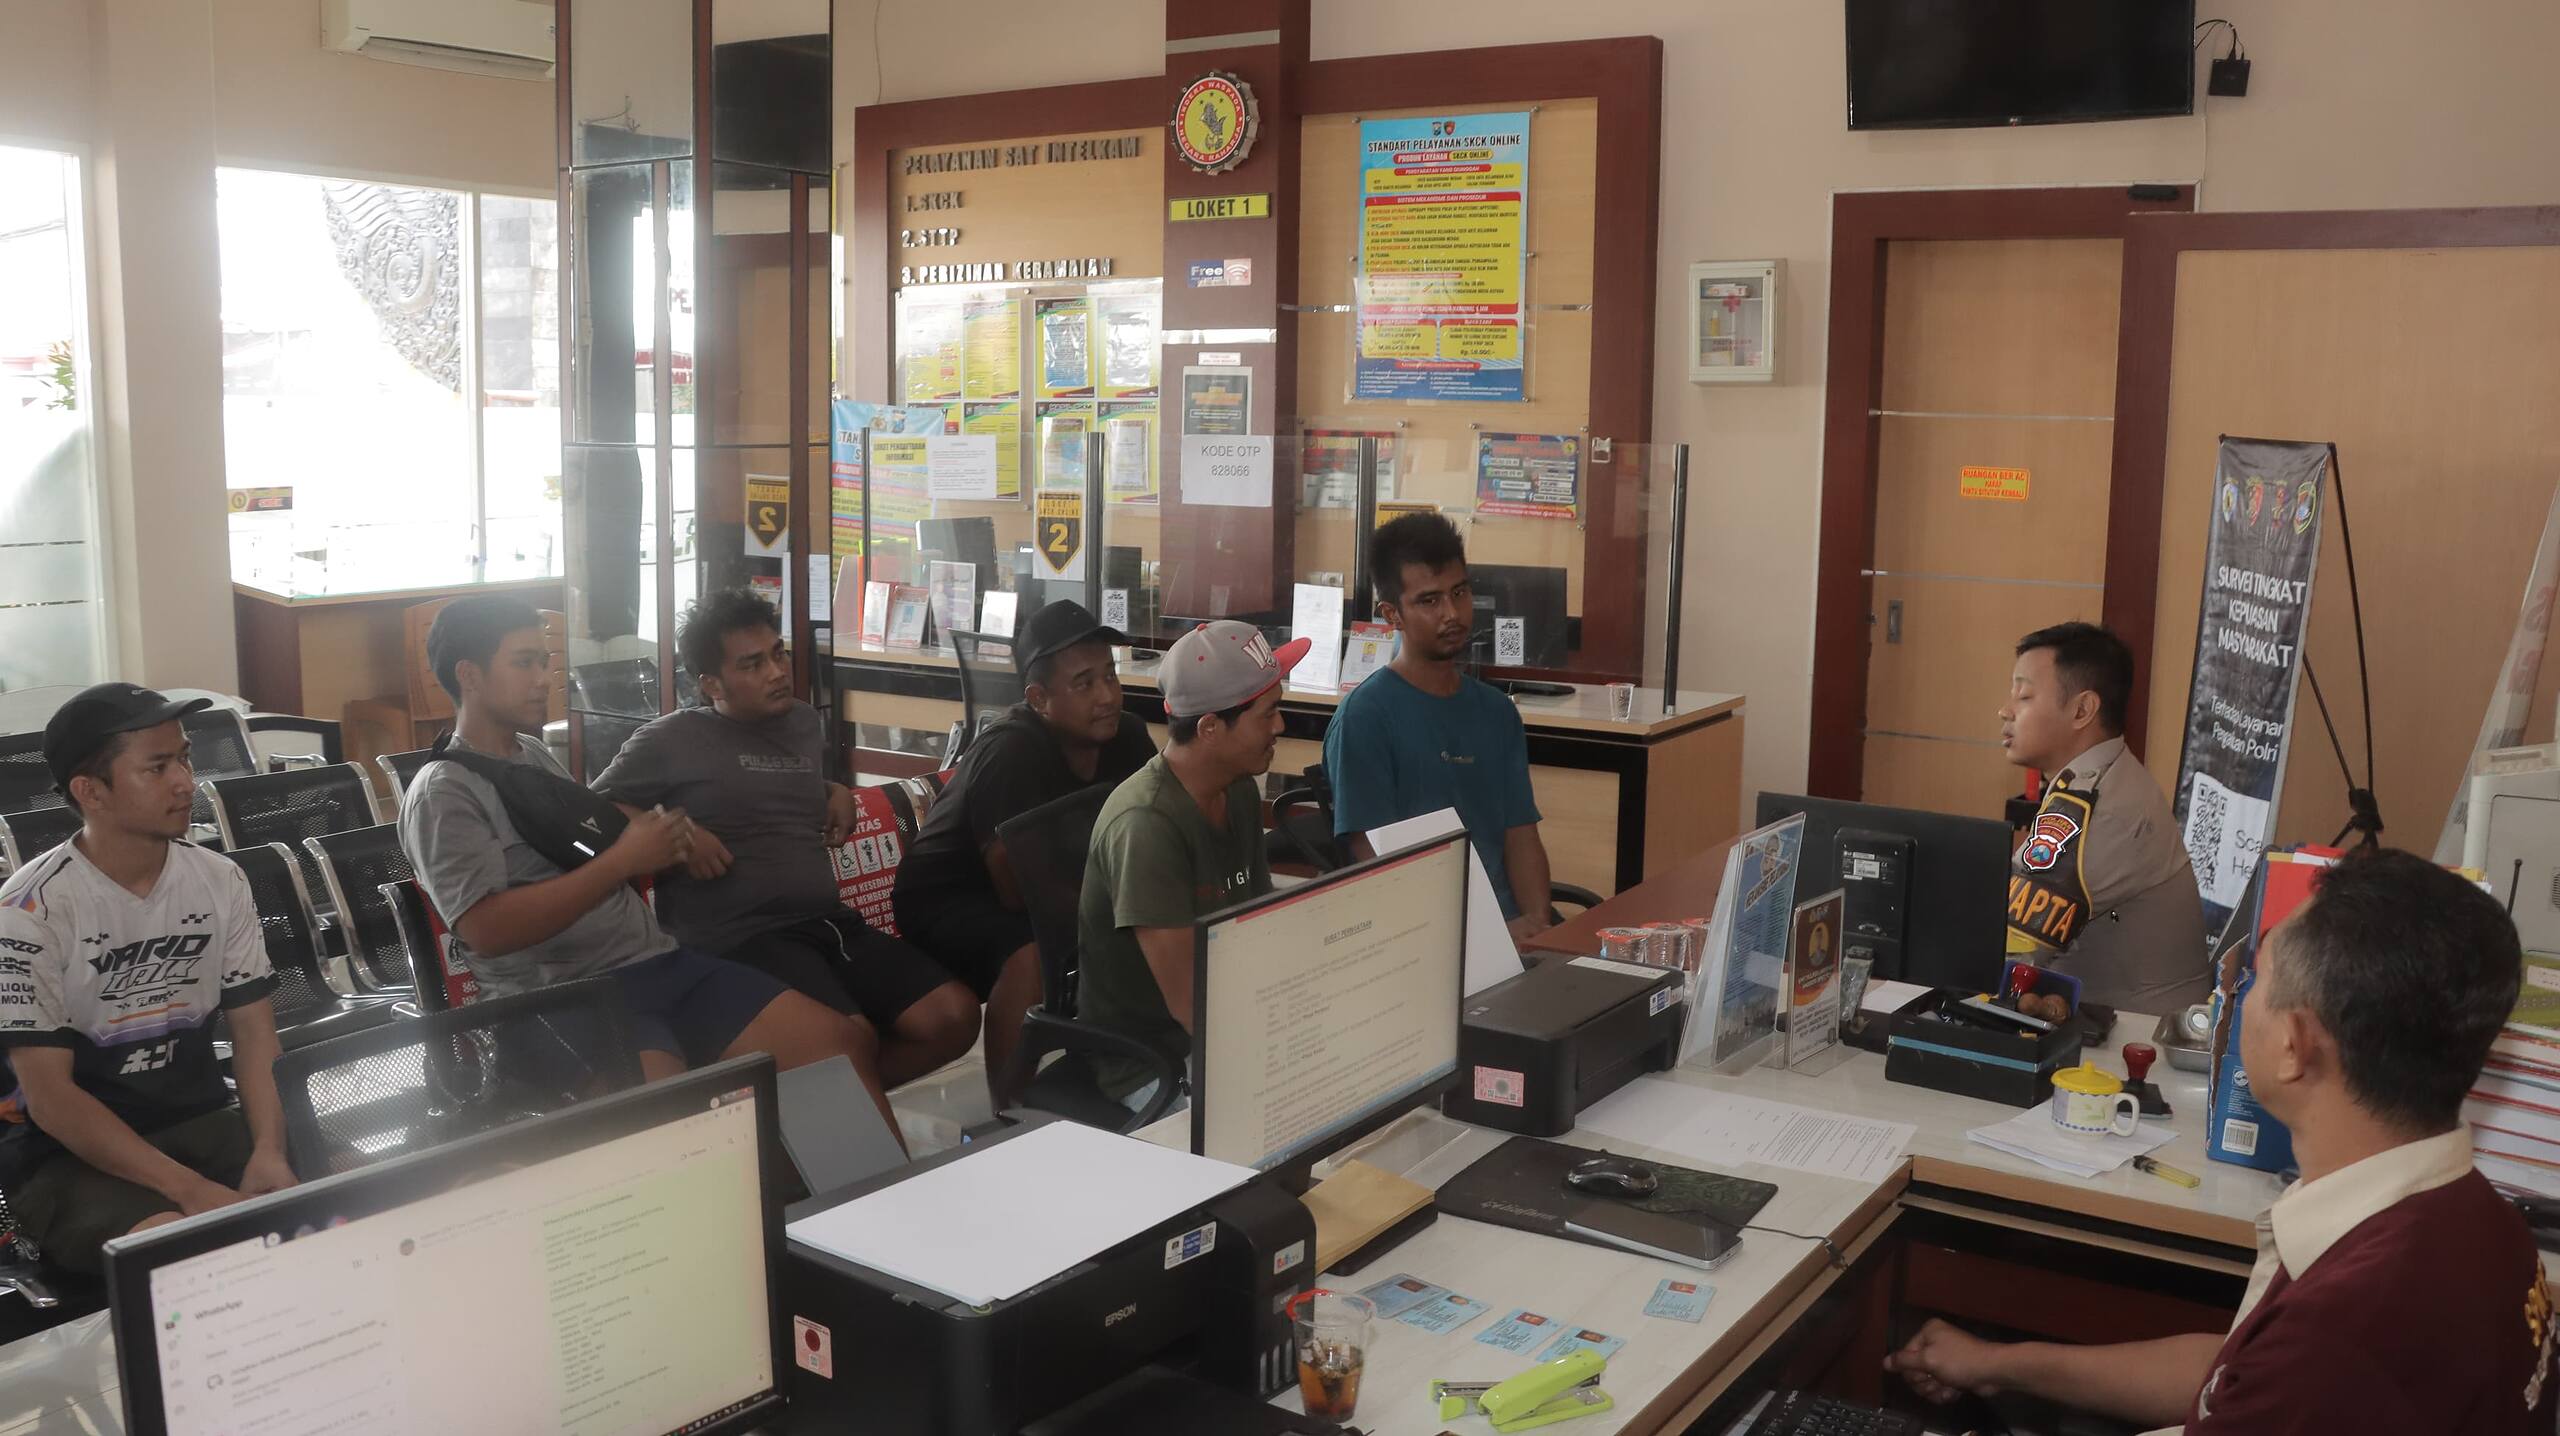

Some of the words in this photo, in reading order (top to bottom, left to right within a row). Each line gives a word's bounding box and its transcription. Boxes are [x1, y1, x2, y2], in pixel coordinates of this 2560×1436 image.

[905, 148, 999, 175] PELAYANAN
[1006, 145, 1039, 167] SAT
[1047, 136, 1140, 163] INTELKAM
[1367, 141, 1411, 153] STANDART
[1413, 138, 1461, 150] PELAYANAN
[1464, 136, 1487, 147] SKCK
[1489, 134, 1521, 146] ONLINE
[1187, 199, 1236, 218] LOKET
[1242, 197, 1250, 215] 1
[1190, 265, 1224, 277] Free
[1201, 445, 1234, 457] KODE
[1237, 445, 1262, 457] OTP
[1211, 464, 1250, 477] 828066
[1048, 522, 1069, 553] 2
[2218, 565, 2254, 595] SURVEI
[2253, 573, 2306, 605] TINGKAT
[2228, 598, 2279, 634] KEPUASAN
[2217, 626, 2294, 668] MASYARAKAT
[2245, 738, 2279, 762] Polri
[2235, 829, 2263, 853] Sca
[1, 994, 36, 1005] MOLY
[194, 1299, 243, 1320] WhatsApp
[1104, 1302, 1137, 1328] EPSON
